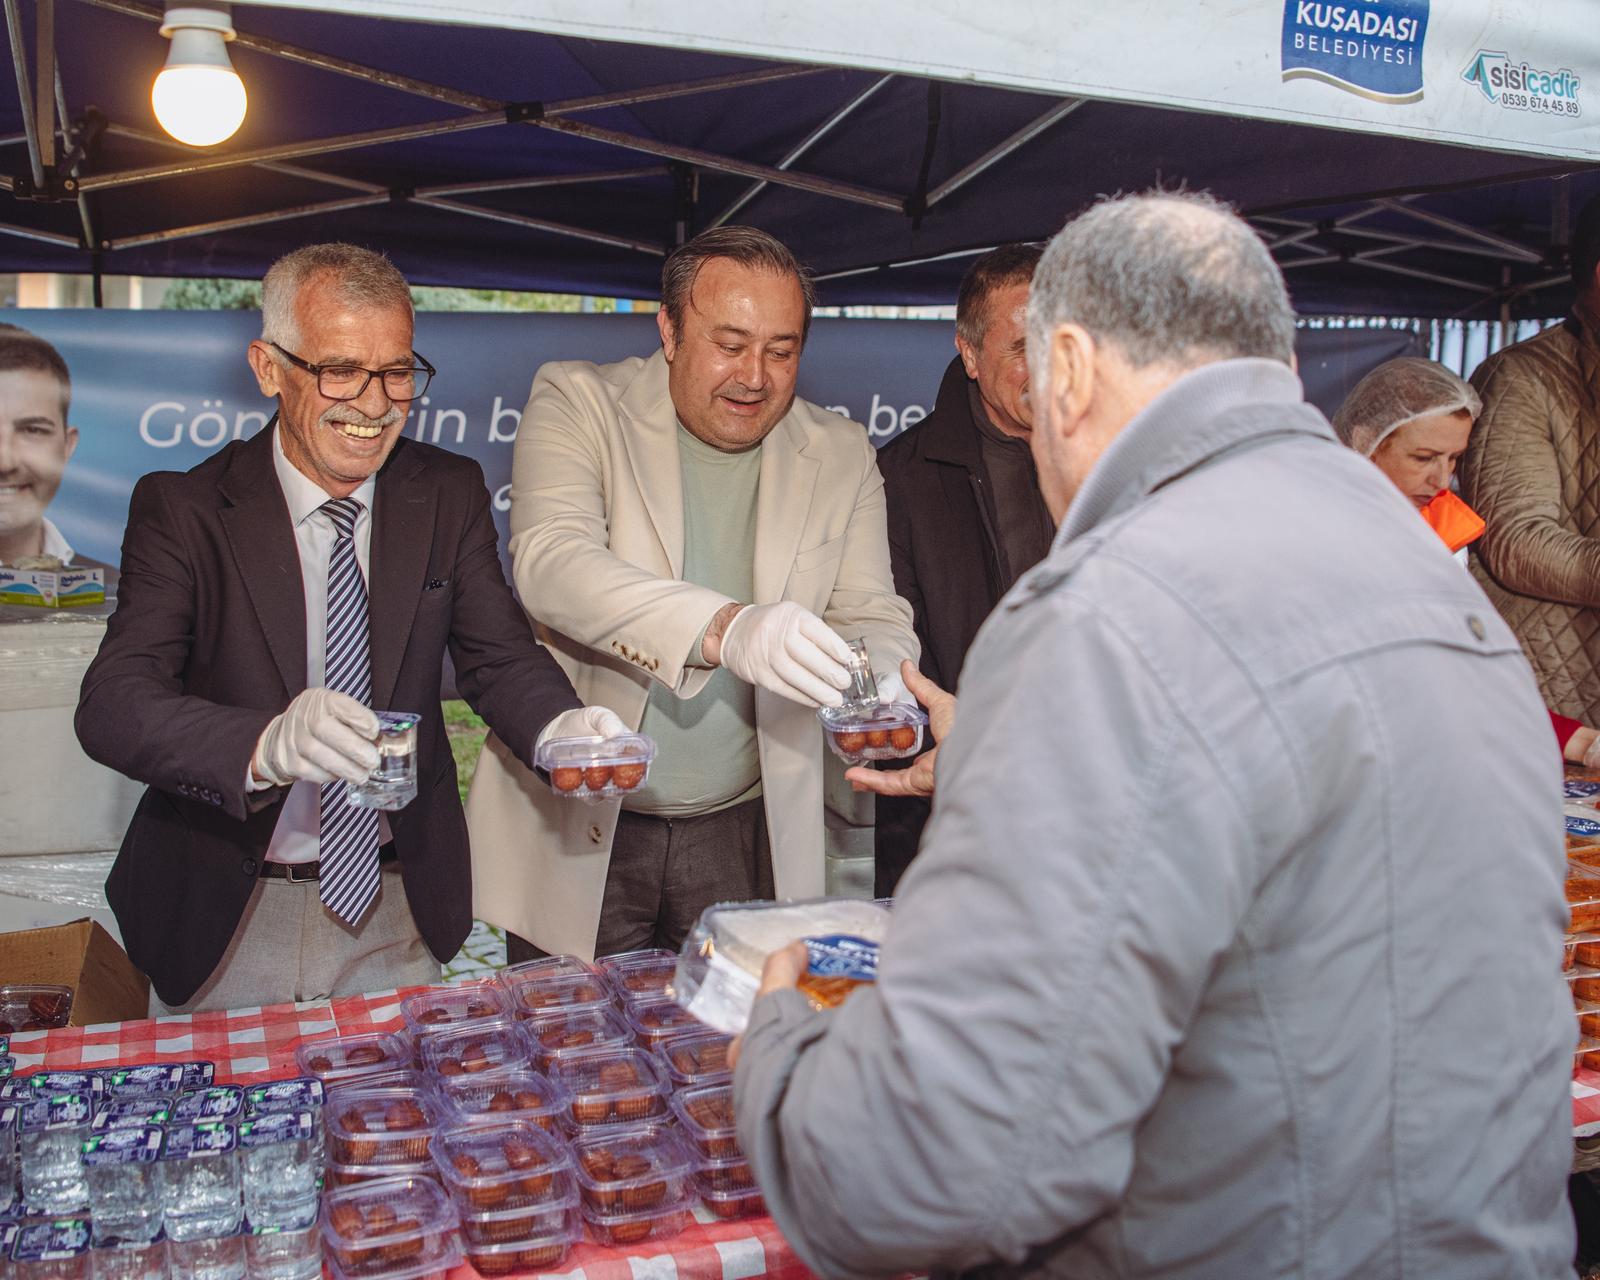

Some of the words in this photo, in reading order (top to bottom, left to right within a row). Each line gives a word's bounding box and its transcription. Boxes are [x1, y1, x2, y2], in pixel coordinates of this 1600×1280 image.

[1296, 1, 1417, 42] KUŞADASI
[1294, 33, 1413, 65] BELEDİYESİ
[1502, 97, 1527, 109] 0539
[1530, 101, 1549, 112] 674
[1552, 104, 1564, 115] 45
[1566, 106, 1578, 117] 89
